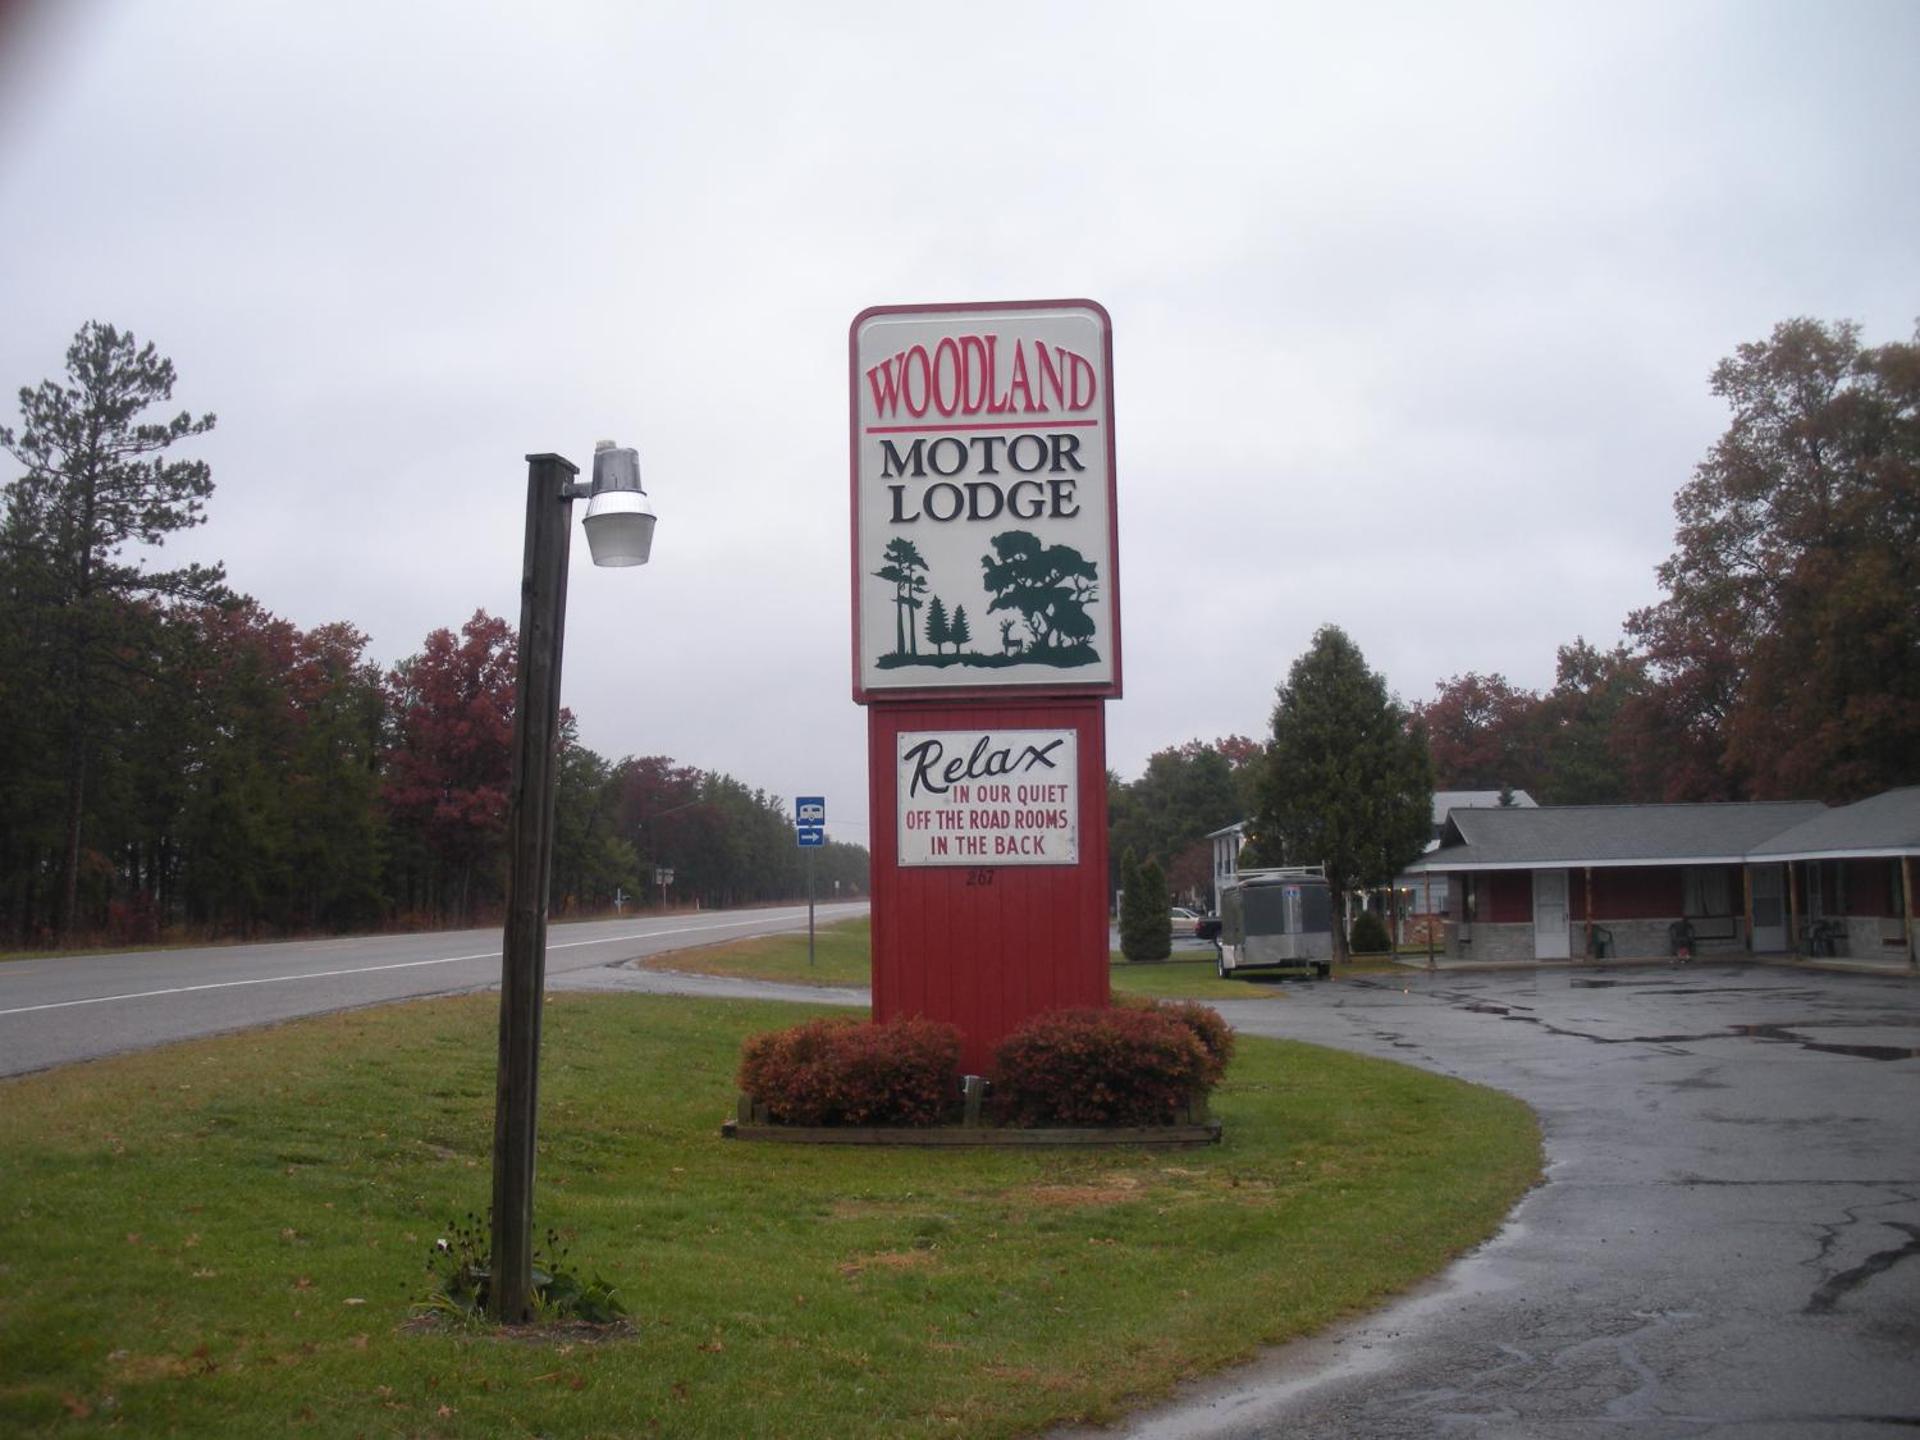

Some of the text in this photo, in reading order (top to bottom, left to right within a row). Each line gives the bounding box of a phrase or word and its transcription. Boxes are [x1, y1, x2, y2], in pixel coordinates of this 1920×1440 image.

[866, 335, 1097, 419] WOODLAND
[880, 433, 1086, 478] MOTOR
[888, 479, 1080, 523] LODGE
[904, 735, 1064, 798] Relax
[953, 784, 1068, 806] IN OUR QUIET
[906, 809, 1068, 830] OFF THE ROAD ROOMS
[931, 835, 1045, 855] IN THE BACK
[966, 870, 995, 886] 267
